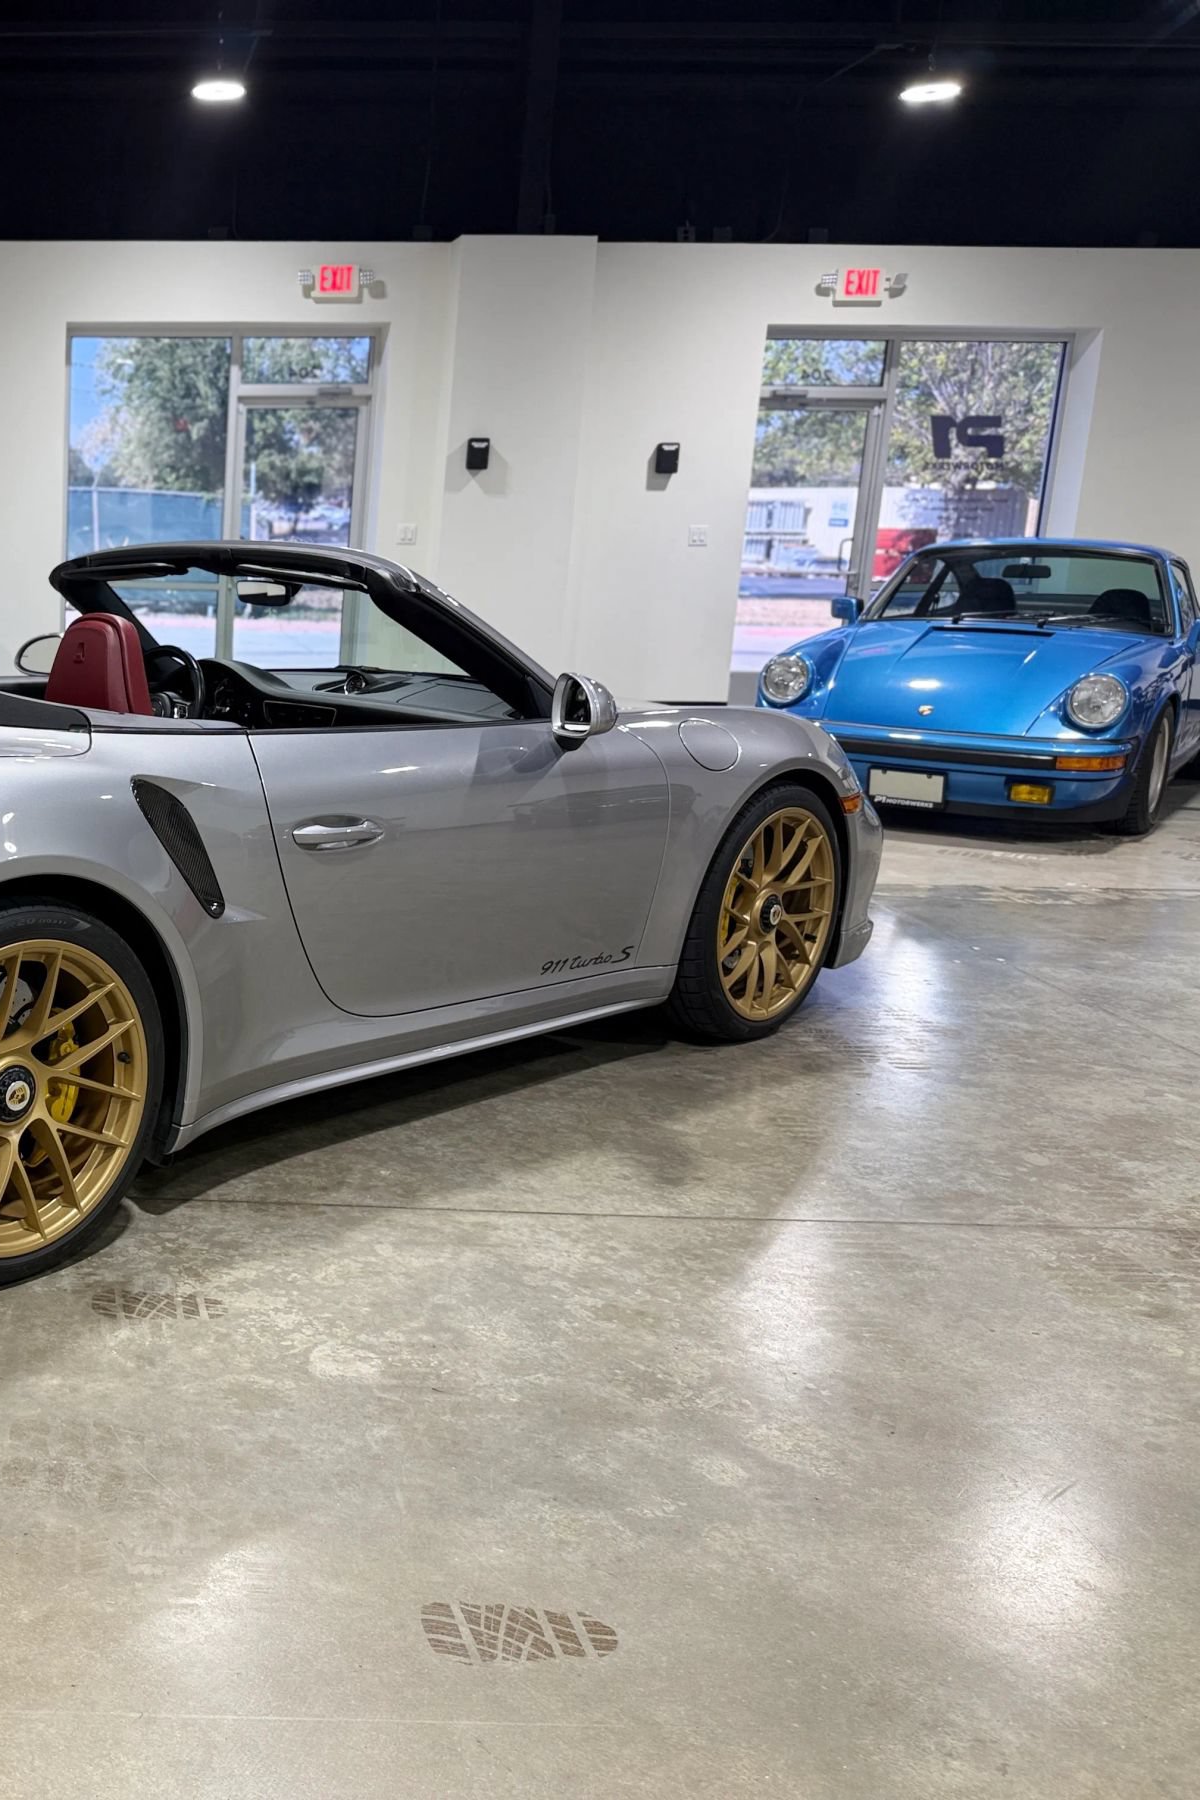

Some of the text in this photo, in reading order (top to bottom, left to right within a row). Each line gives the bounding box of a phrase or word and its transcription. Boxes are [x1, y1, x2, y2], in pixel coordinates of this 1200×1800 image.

[319, 264, 354, 293] EXIT
[844, 268, 881, 296] EXIT
[540, 958, 568, 975] 911
[611, 945, 635, 964] S
